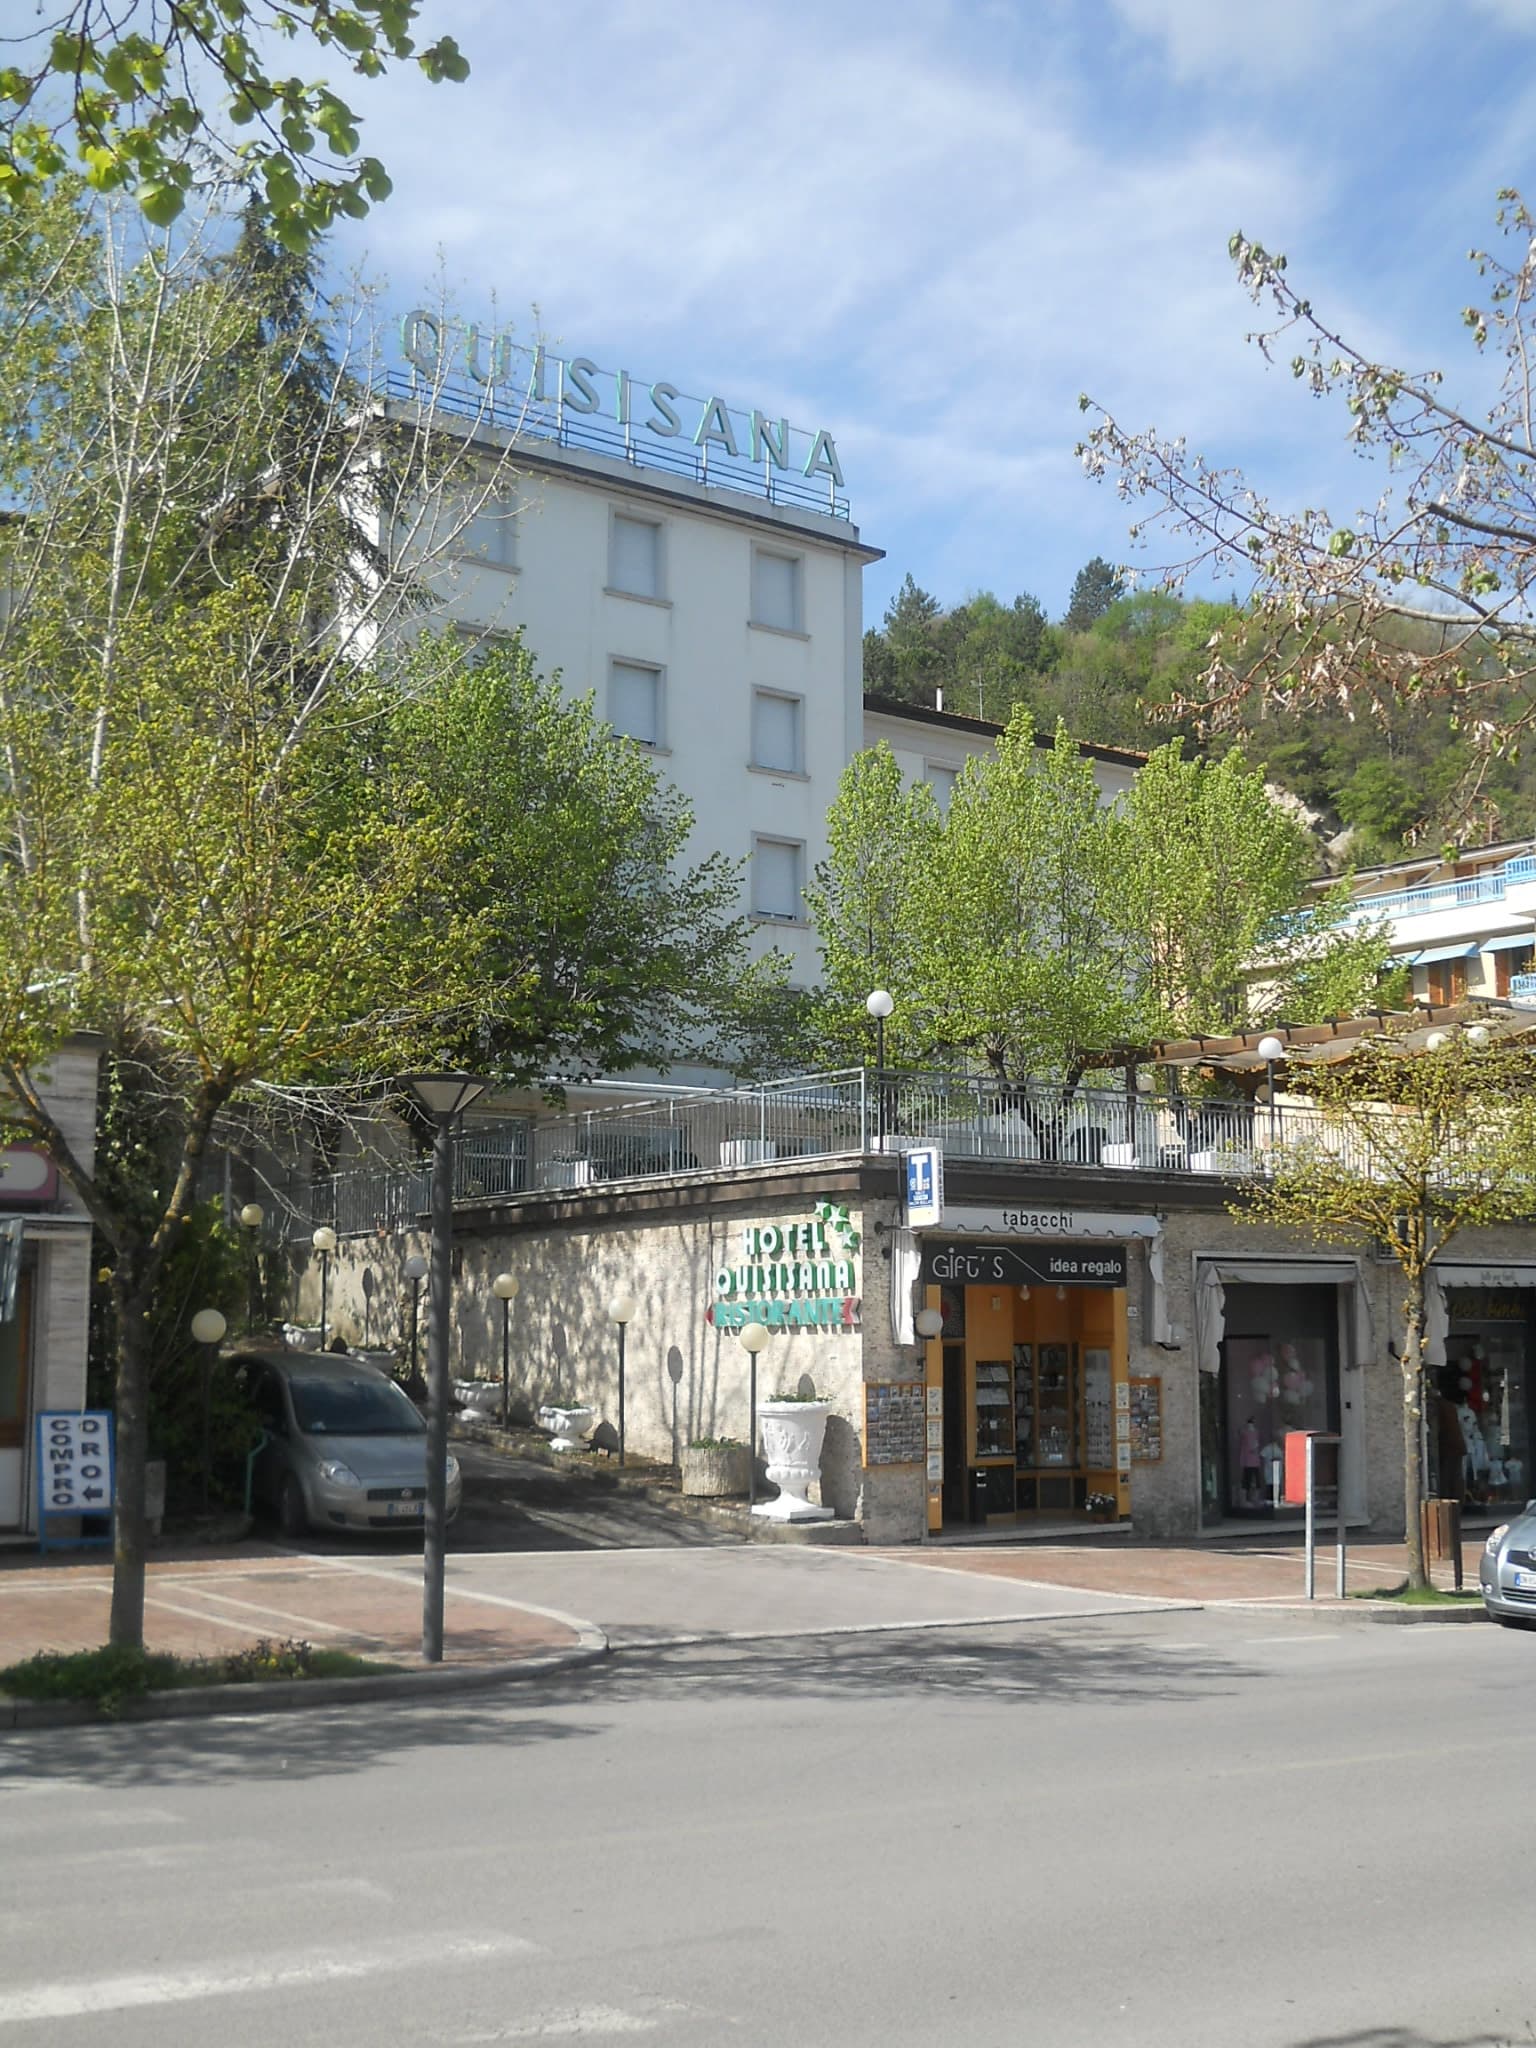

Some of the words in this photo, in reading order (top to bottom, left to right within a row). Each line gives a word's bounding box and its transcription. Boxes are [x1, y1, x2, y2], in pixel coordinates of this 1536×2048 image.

[400, 310, 844, 487] QUISISANA
[1003, 1210, 1073, 1228] tabacchi
[743, 1222, 828, 1256] HOTEL
[715, 1259, 854, 1296] QUISISANA
[1050, 1257, 1078, 1273] idea
[1081, 1259, 1122, 1276] regalo
[713, 1297, 844, 1327] RISTORANTE
[50, 1419, 74, 1505] COMPRO
[80, 1419, 102, 1479] ORO
